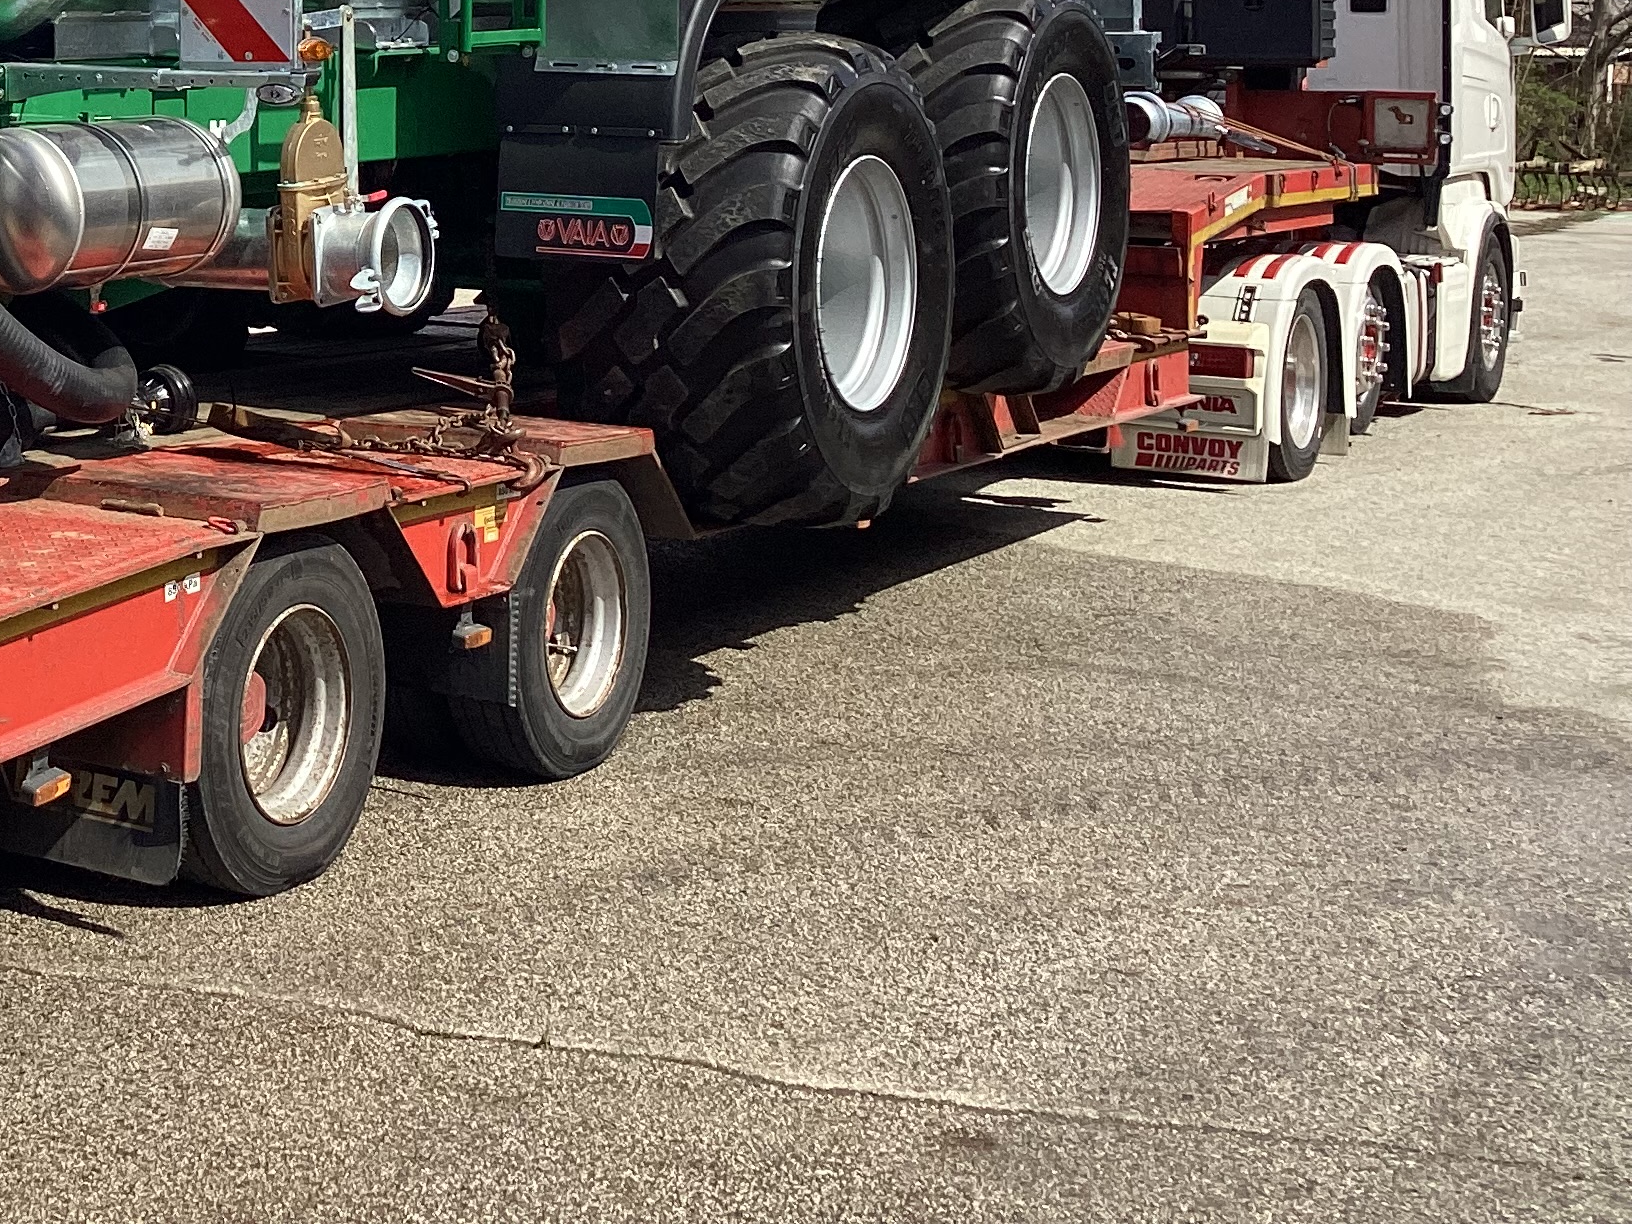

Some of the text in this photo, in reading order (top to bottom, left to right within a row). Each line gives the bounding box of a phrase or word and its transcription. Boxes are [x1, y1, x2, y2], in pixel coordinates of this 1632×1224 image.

[556, 217, 611, 248] VAIA
[1136, 431, 1244, 460] CONVOY
[1185, 455, 1241, 476] PARTS
